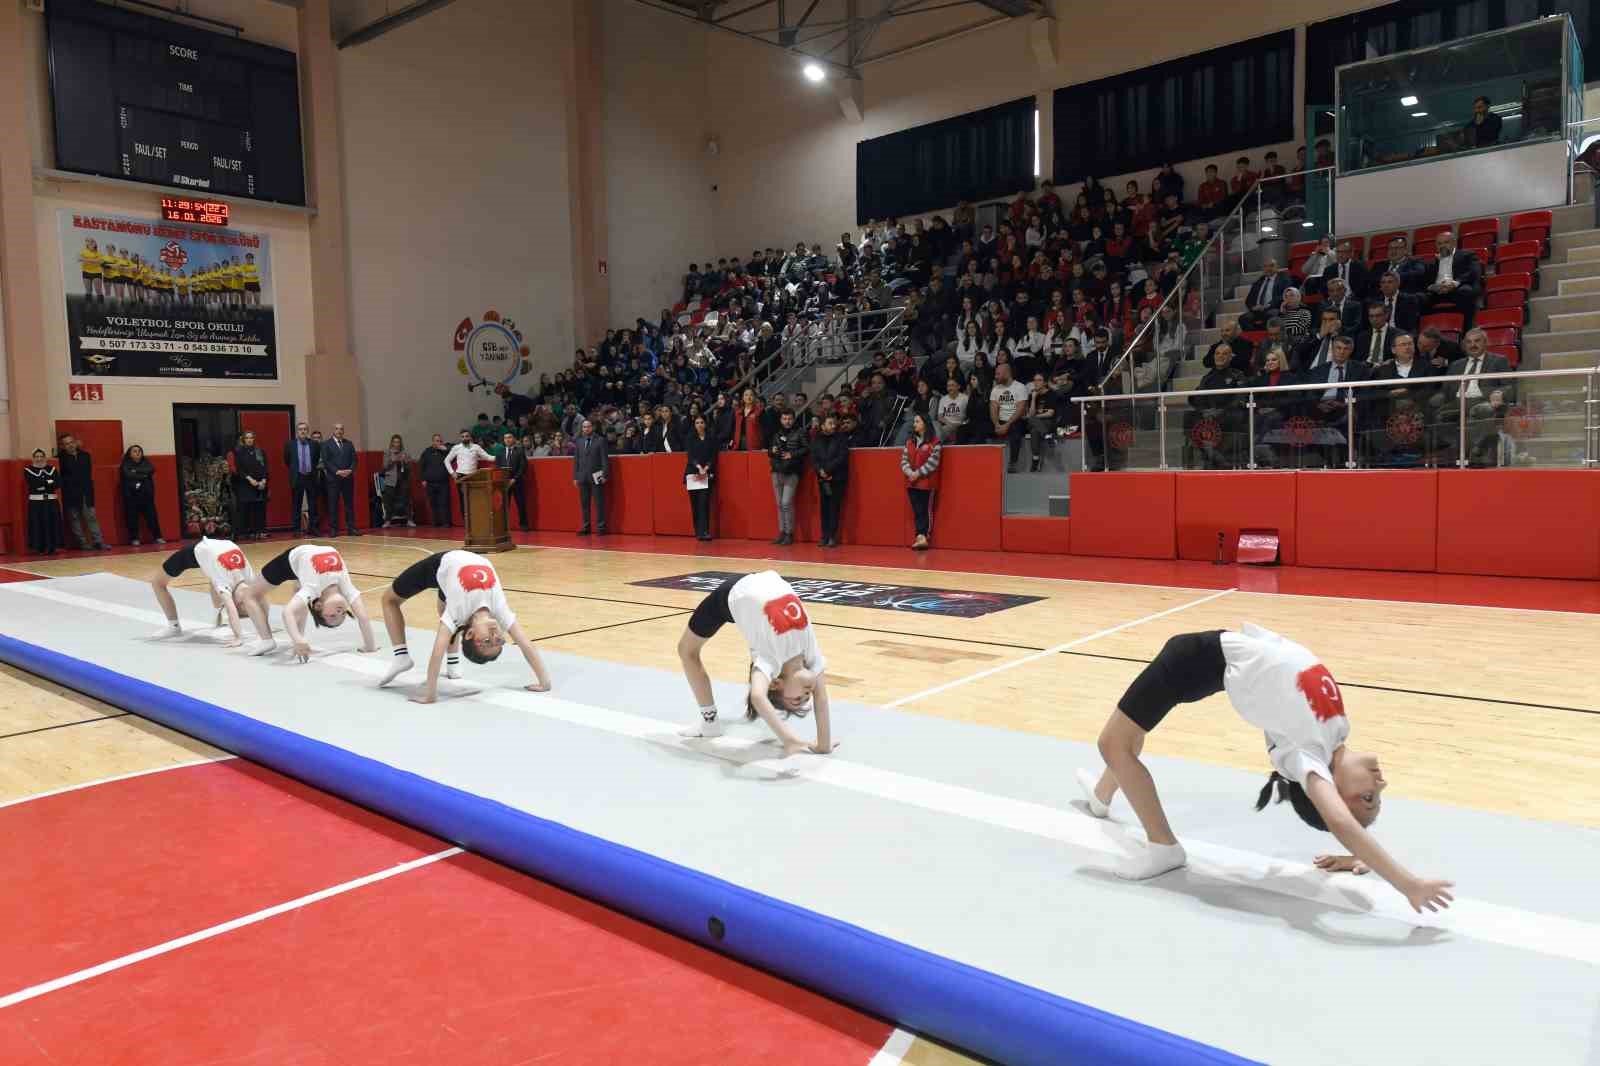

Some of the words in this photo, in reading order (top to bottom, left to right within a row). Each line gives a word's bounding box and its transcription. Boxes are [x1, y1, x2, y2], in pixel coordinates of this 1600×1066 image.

[169, 44, 199, 60] SCORE
[135, 143, 167, 160] FAUL/SET
[213, 155, 242, 172] FAUL/SET
[106, 316, 172, 329] VOLEYBOL
[174, 320, 205, 330] SPOR
[207, 322, 244, 332] OKULU
[100, 338, 106, 348] 0
[109, 340, 127, 349] 507
[130, 341, 147, 350] 173
[149, 341, 161, 350] 33
[163, 342, 175, 351] 71
[183, 343, 189, 351] 0
[242, 345, 252, 354] 10
